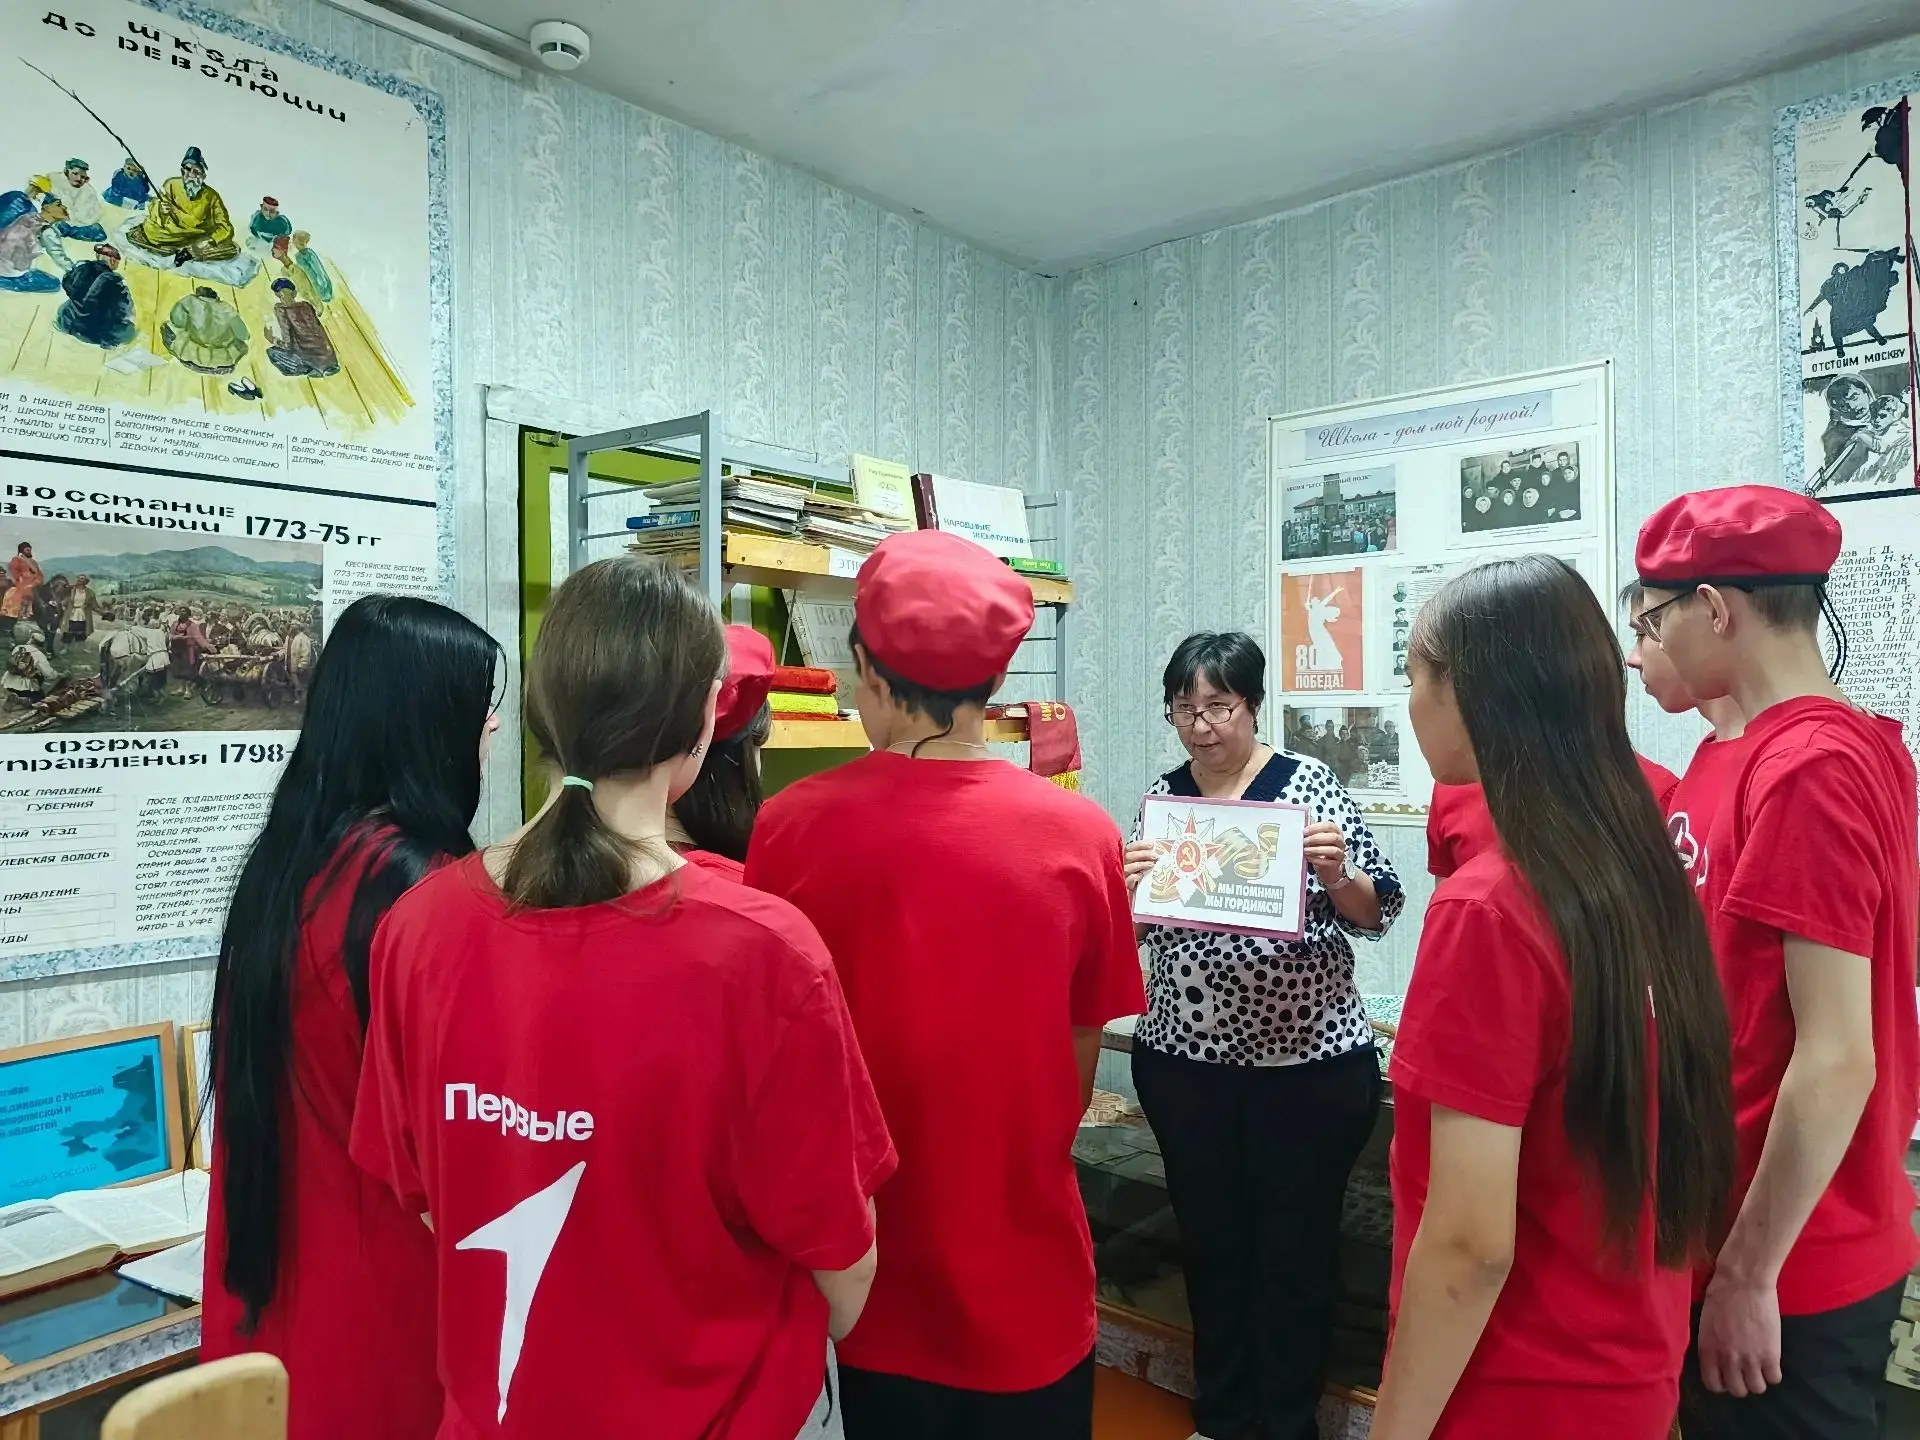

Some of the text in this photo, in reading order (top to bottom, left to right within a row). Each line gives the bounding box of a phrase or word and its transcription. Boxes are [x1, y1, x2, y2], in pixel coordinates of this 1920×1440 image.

[42, 11, 96, 37] ДО
[1812, 348, 1905, 372] ОТСТОИМ МОСКВУ
[20, 394, 27, 402] В
[33, 397, 72, 408] НАШЕЙ
[17, 407, 105, 423] ШКОЛЫ НЕ БЫЛО
[14, 417, 53, 428] МУЛЛЫ
[69, 424, 95, 434] СЕБЯ
[114, 420, 174, 434] ВЫПОЛНЯЛИ
[1318, 402, 1540, 448] Школа дом мой родной!
[0, 426, 107, 446] ТСТВУЮЩУЮ ПЛАТУ
[301, 438, 334, 448] ДРУГОМ
[172, 449, 229, 462] ОБУЧАЛИСЬ
[233, 457, 279, 468] ОТДЕЛЬНО
[319, 449, 367, 461] ДОСТУПНО
[246, 515, 350, 545] 1773-75
[1830, 563, 1891, 574] РСЛАНОВ
[1835, 557, 1876, 567] СЛАНОВ
[1830, 569, 1910, 581] ХМЕТЬЯНОВ
[1295, 673, 1344, 690] ПОБЕДА!
[1838, 675, 1912, 685] БДРАХИМОВ
[0, 786, 103, 798] СКОЕ ПРАВЛЕНИЕ
[146, 797, 177, 805] ПОСЛЕ
[243, 792, 273, 800] ВОССТА
[26, 801, 94, 812] ГУБЕРНИЯ
[139, 807, 181, 817] ЦАРСКОЕ
[42, 828, 77, 837] УЕЗД
[136, 828, 179, 838] ПРОВЕЛО
[147, 844, 250, 858] ОСНОВНАЯ ТЕРРИТОР
[0, 851, 110, 866] ЛЕВСКАЯ ВОЛОСТЬ
[136, 871, 160, 880] СКОЙ
[135, 881, 167, 891] СТОЯЛ
[1217, 882, 1283, 900] МЫ ПОМНИМ!
[3, 887, 81, 902] ПРАВЛЕНИЕ
[0, 906, 21, 914] НЫ
[1204, 894, 1283, 914] МЫ ГОРДИМСЯ!
[445, 1083, 595, 1142] Первые
